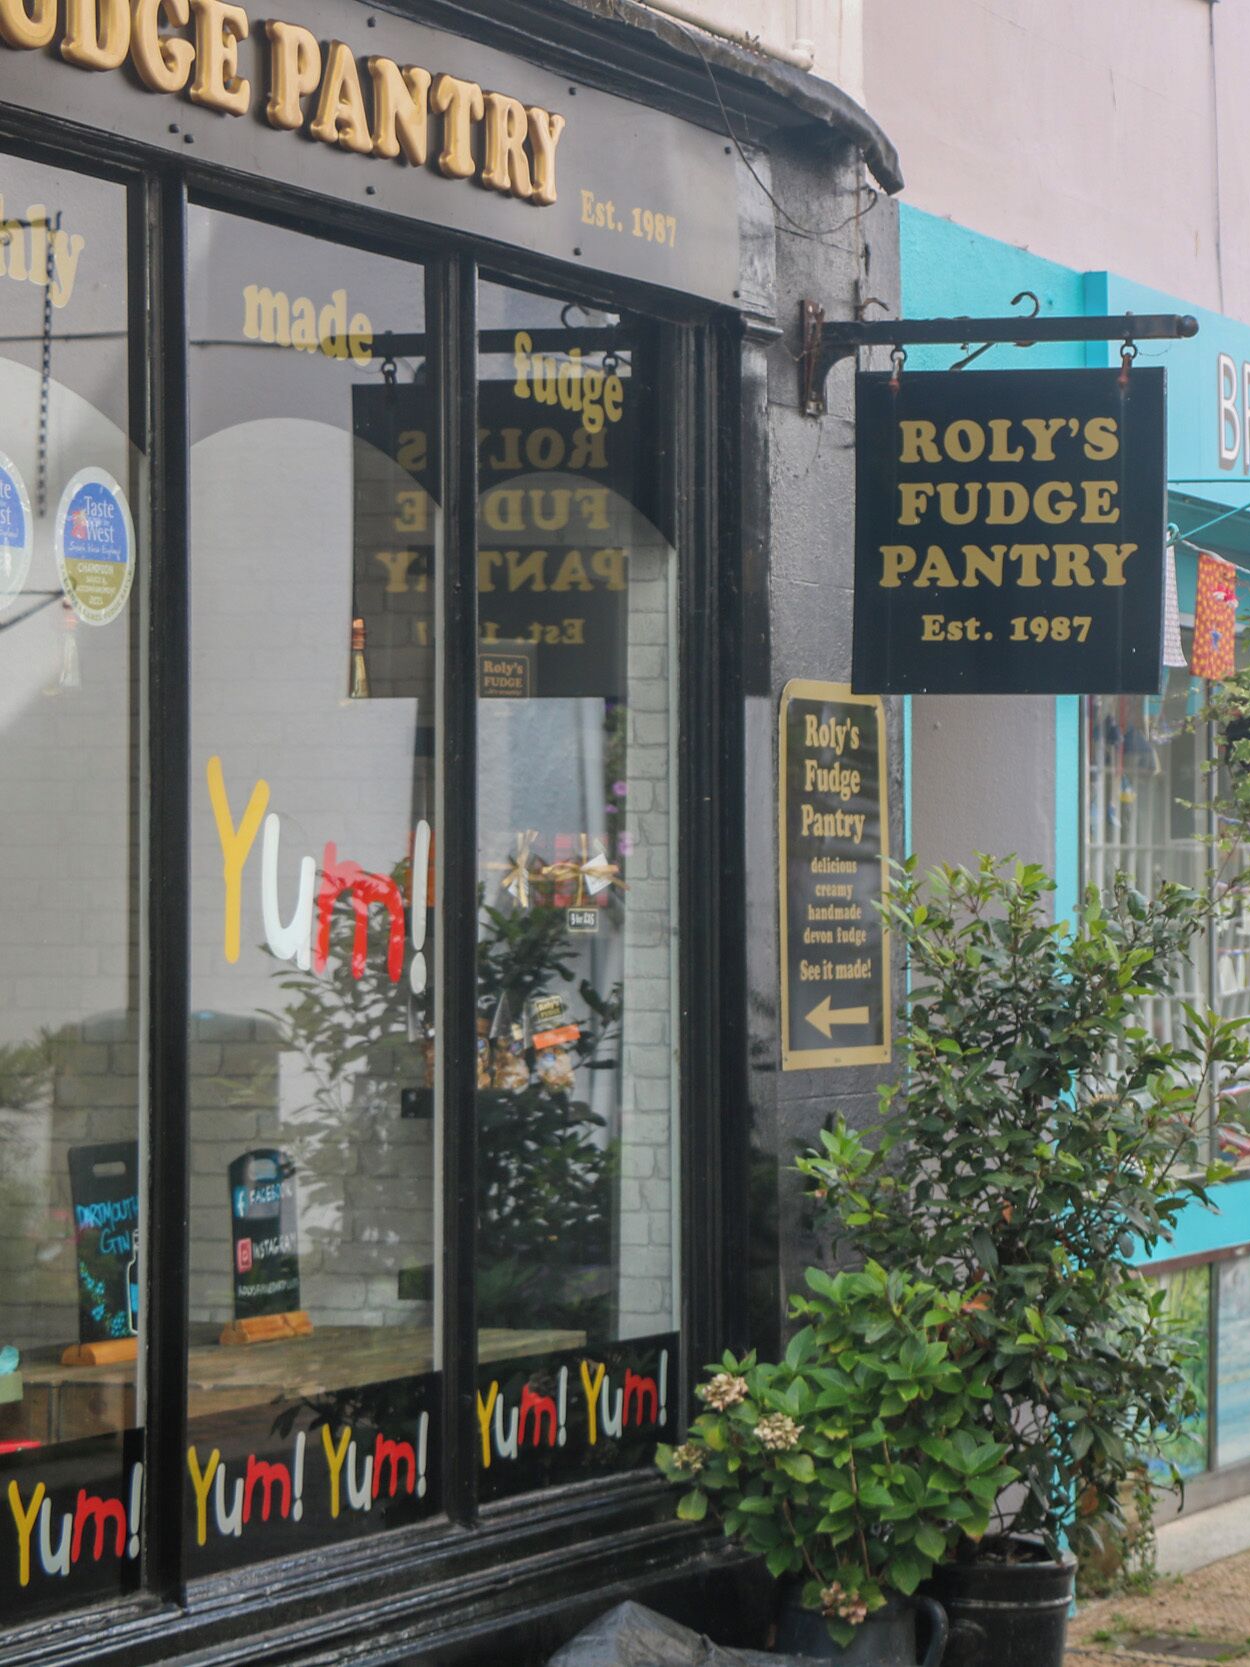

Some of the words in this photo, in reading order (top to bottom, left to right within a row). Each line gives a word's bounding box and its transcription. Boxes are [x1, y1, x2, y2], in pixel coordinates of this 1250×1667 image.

[265, 18, 566, 205] PANTRY
[580, 190, 622, 228] Est.
[632, 207, 677, 249] 1987
[243, 284, 373, 366] made
[513, 332, 624, 433] fudge
[900, 417, 1120, 463] ROLY'S
[84, 495, 114, 519] Taste
[897, 480, 1121, 525] FUDGE
[86, 520, 114, 543] West
[878, 543, 1138, 588] PANTRY
[921, 615, 993, 642] Est.
[1010, 616, 1092, 643] 1987
[483, 659, 524, 677] Roly's
[484, 676, 523, 688] FUDGE
[805, 714, 860, 755] Roly's
[804, 758, 861, 801] Fudge
[801, 804, 865, 845] Pantry
[207, 755, 431, 994] Yum!
[811, 857, 857, 874] delicious
[808, 904, 862, 921] handmade
[815, 883, 854, 901] creamy
[803, 927, 833, 944] devon
[836, 926, 867, 946] fudge
[800, 959, 822, 981] See
[823, 959, 833, 980] it
[835, 957, 872, 980] made!
[476, 1380, 569, 1469] Yum!
[580, 1349, 669, 1446] Yum!
[187, 1431, 306, 1546] Yum!
[321, 1411, 430, 1518] Yum!
[7, 1461, 143, 1587] Yum!
